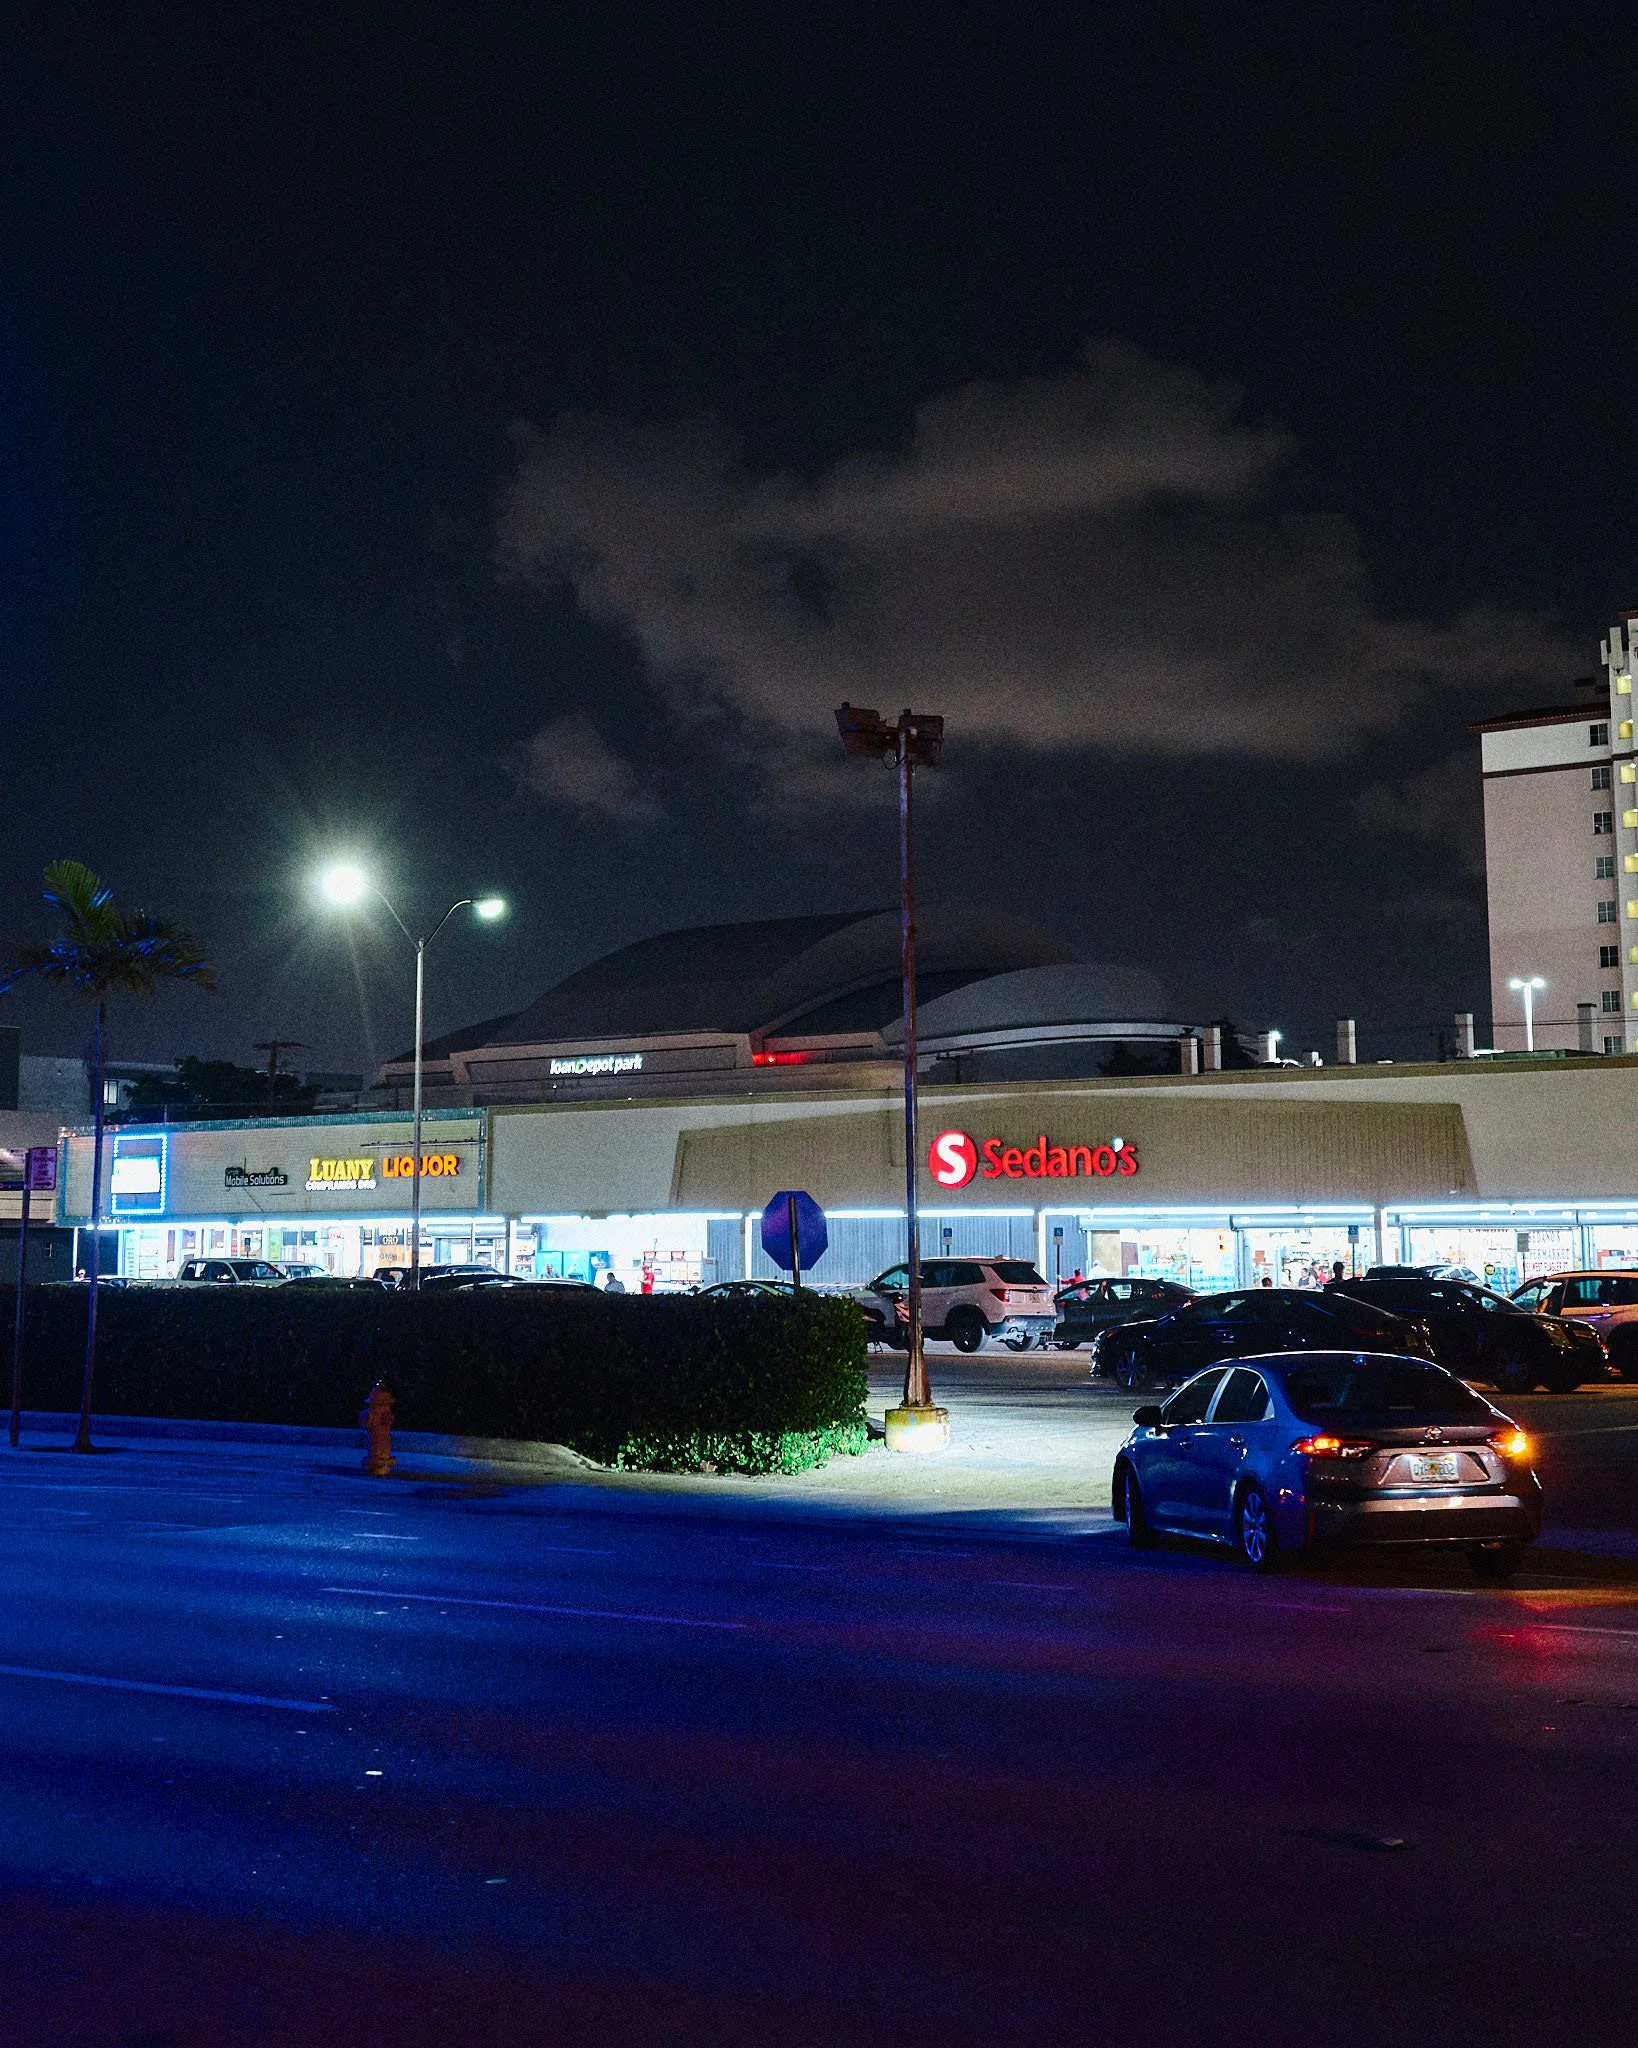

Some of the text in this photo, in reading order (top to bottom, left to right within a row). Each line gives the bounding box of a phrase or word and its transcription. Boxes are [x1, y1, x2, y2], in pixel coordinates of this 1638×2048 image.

[550, 1054, 642, 1075] loanDepot park
[309, 1158, 374, 1181] LUANY
[937, 1133, 1138, 1184] S Sedano's
[226, 1174, 285, 1187] Mobile Solutions
